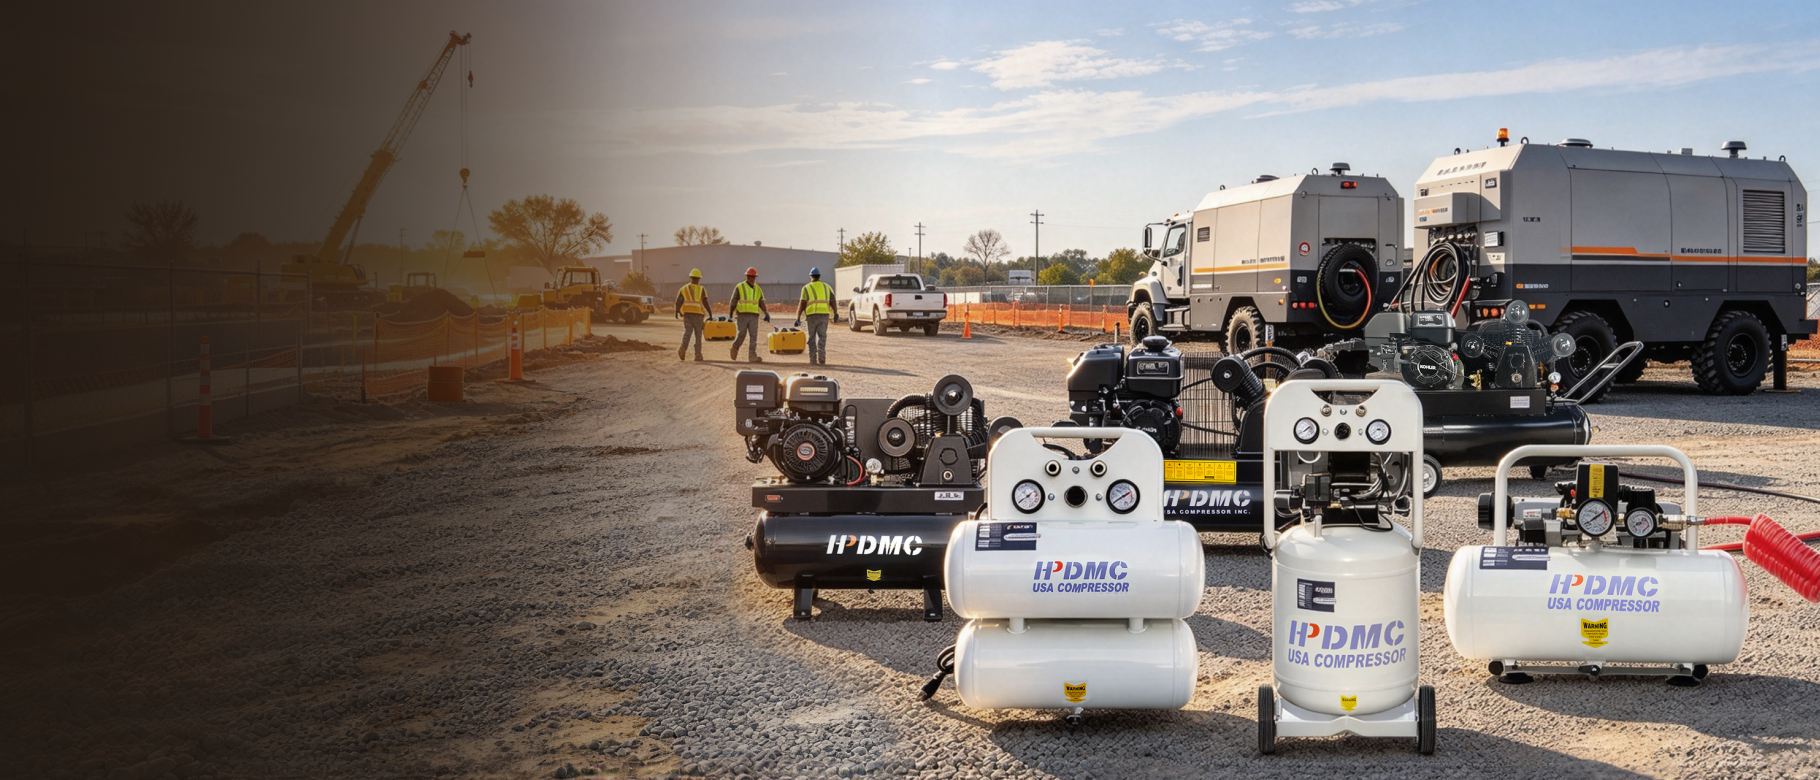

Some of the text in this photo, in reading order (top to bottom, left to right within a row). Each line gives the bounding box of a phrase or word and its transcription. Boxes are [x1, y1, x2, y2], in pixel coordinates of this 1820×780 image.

[1164, 490, 1250, 506] HPDMC
[826, 534, 923, 556] HPDMC
[1033, 560, 1128, 581] HPDMC
[1032, 582, 1130, 593] USA COMPRESSOR
[1549, 574, 1658, 597] HPDMC
[1547, 597, 1660, 612] USA COMPRESSOR
[1288, 619, 1405, 650] HPDMC
[1288, 647, 1407, 668] USA COMPRESSOR
